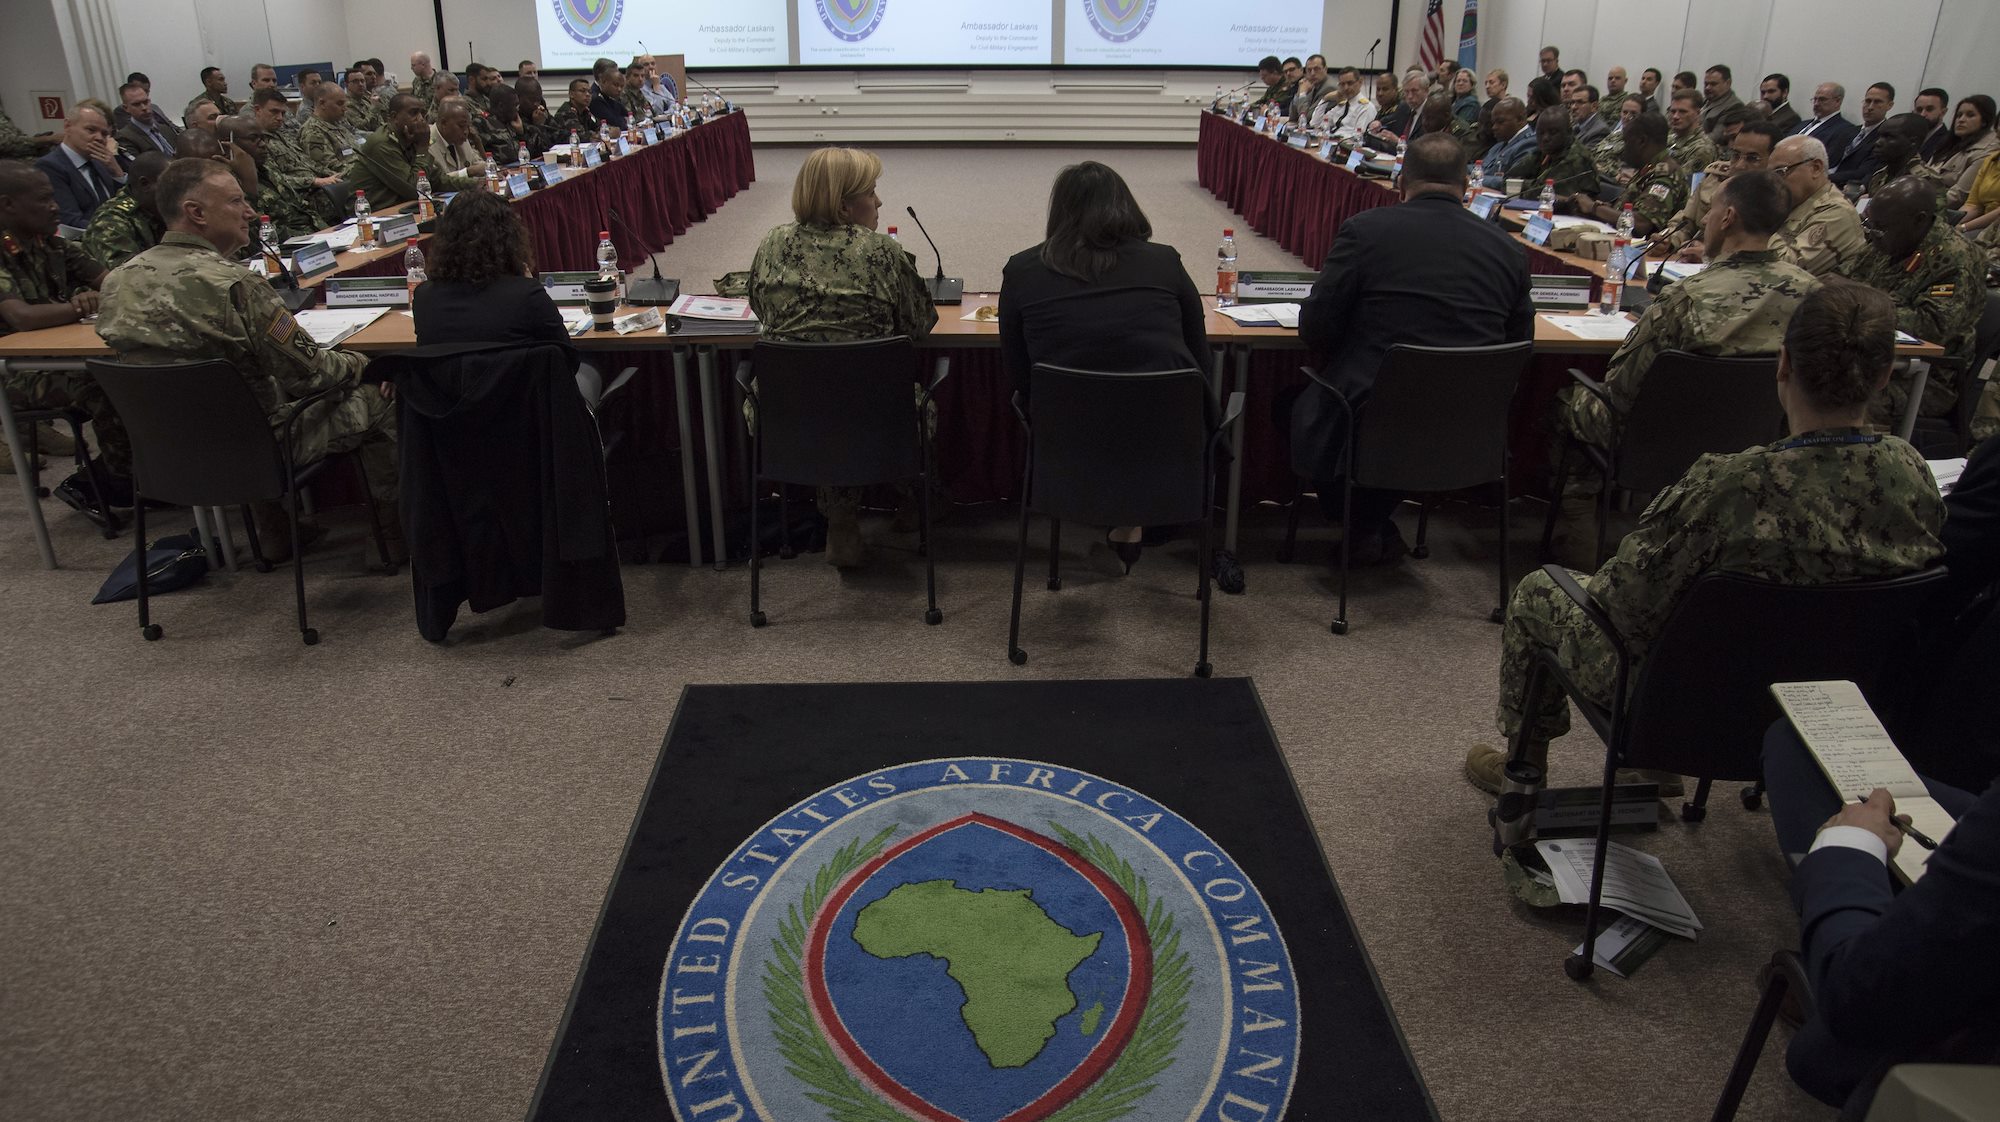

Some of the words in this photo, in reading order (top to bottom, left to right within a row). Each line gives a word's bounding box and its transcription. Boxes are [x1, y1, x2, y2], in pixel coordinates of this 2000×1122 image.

[698, 24, 746, 33] Ambassador
[961, 22, 1009, 31] Ambassador
[1230, 24, 1278, 33] Ambassador
[671, 917, 745, 1122] UNITED
[722, 776, 896, 891] STATES
[940, 763, 1163, 833] AFRICA
[1183, 850, 1287, 1122] COMMAND
